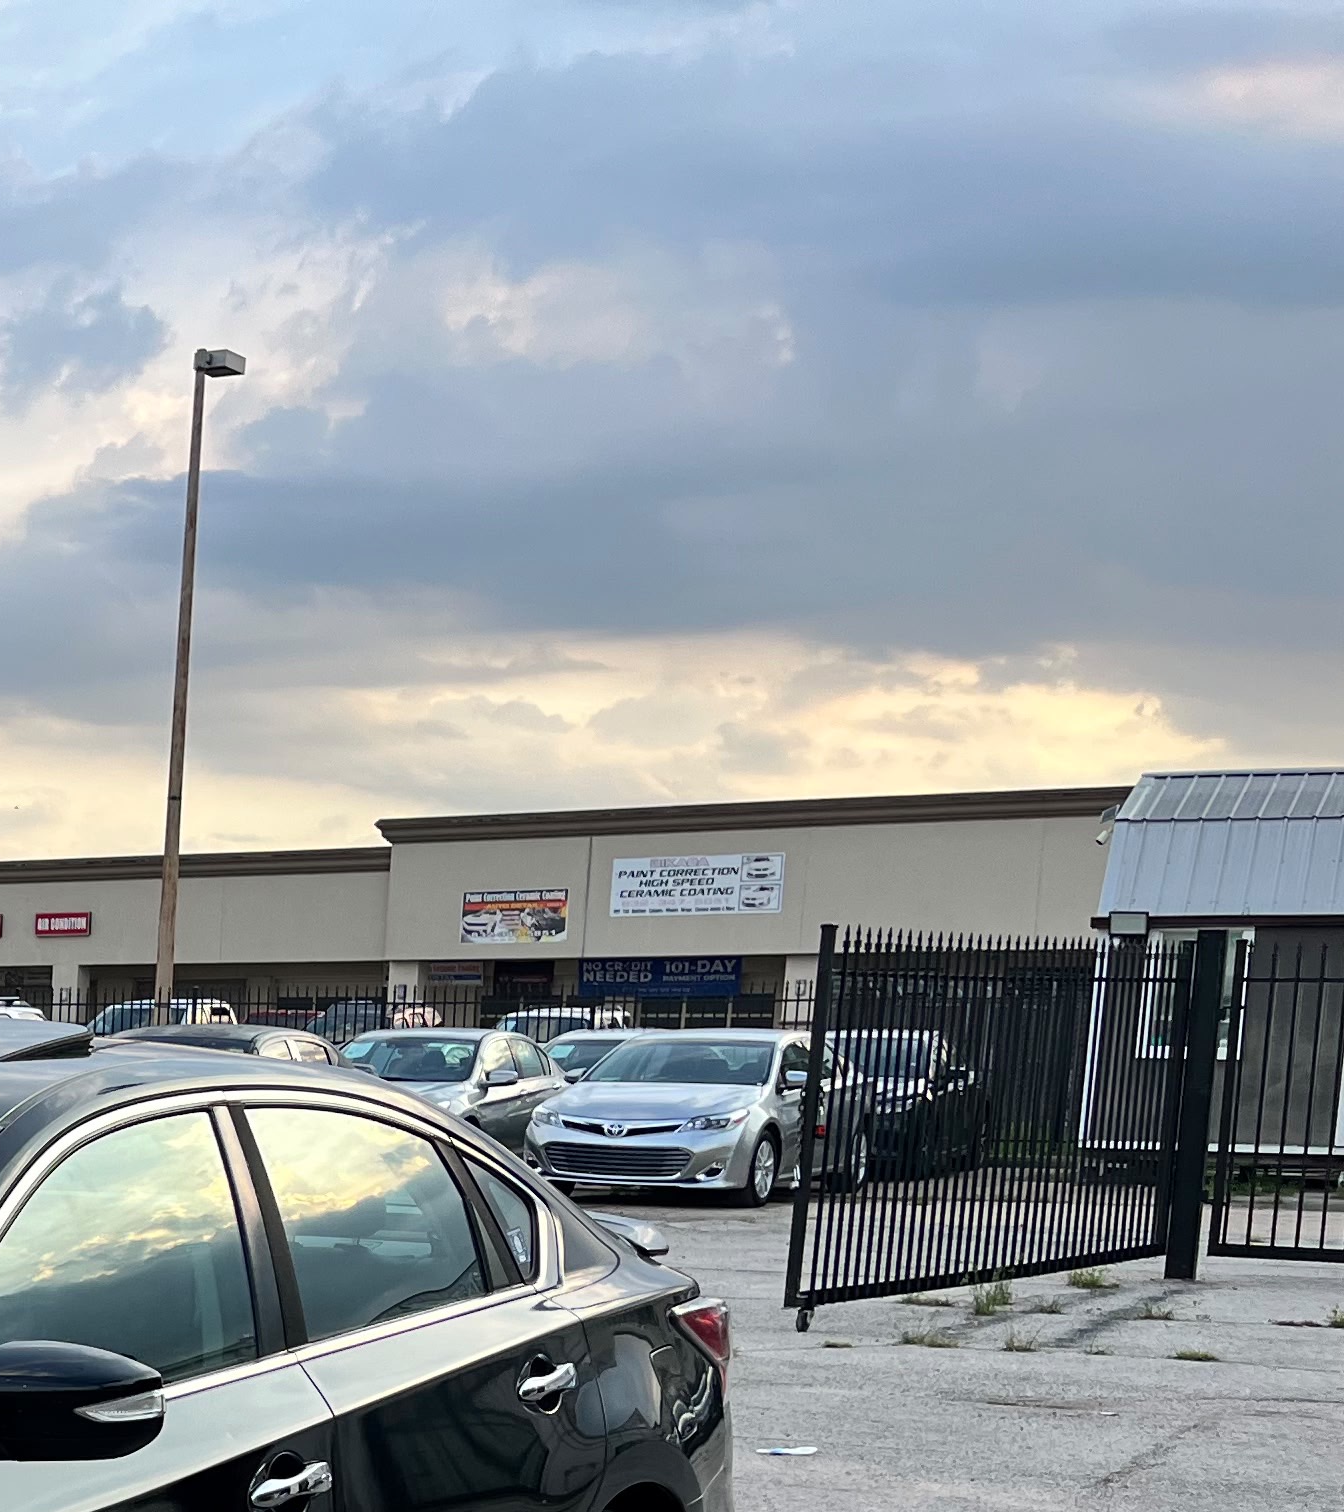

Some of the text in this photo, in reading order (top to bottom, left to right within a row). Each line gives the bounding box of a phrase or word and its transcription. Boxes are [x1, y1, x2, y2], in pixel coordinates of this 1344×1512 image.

[618, 867, 739, 878] PAINT CORRECTION
[639, 877, 714, 887] HIGH SPEED
[620, 887, 734, 898] CERAMIC COATING
[582, 961, 602, 972] NO
[663, 959, 737, 974] 101-DAY
[582, 971, 653, 983] NEEDED
[662, 973, 736, 982] PAYMENT OPTION
